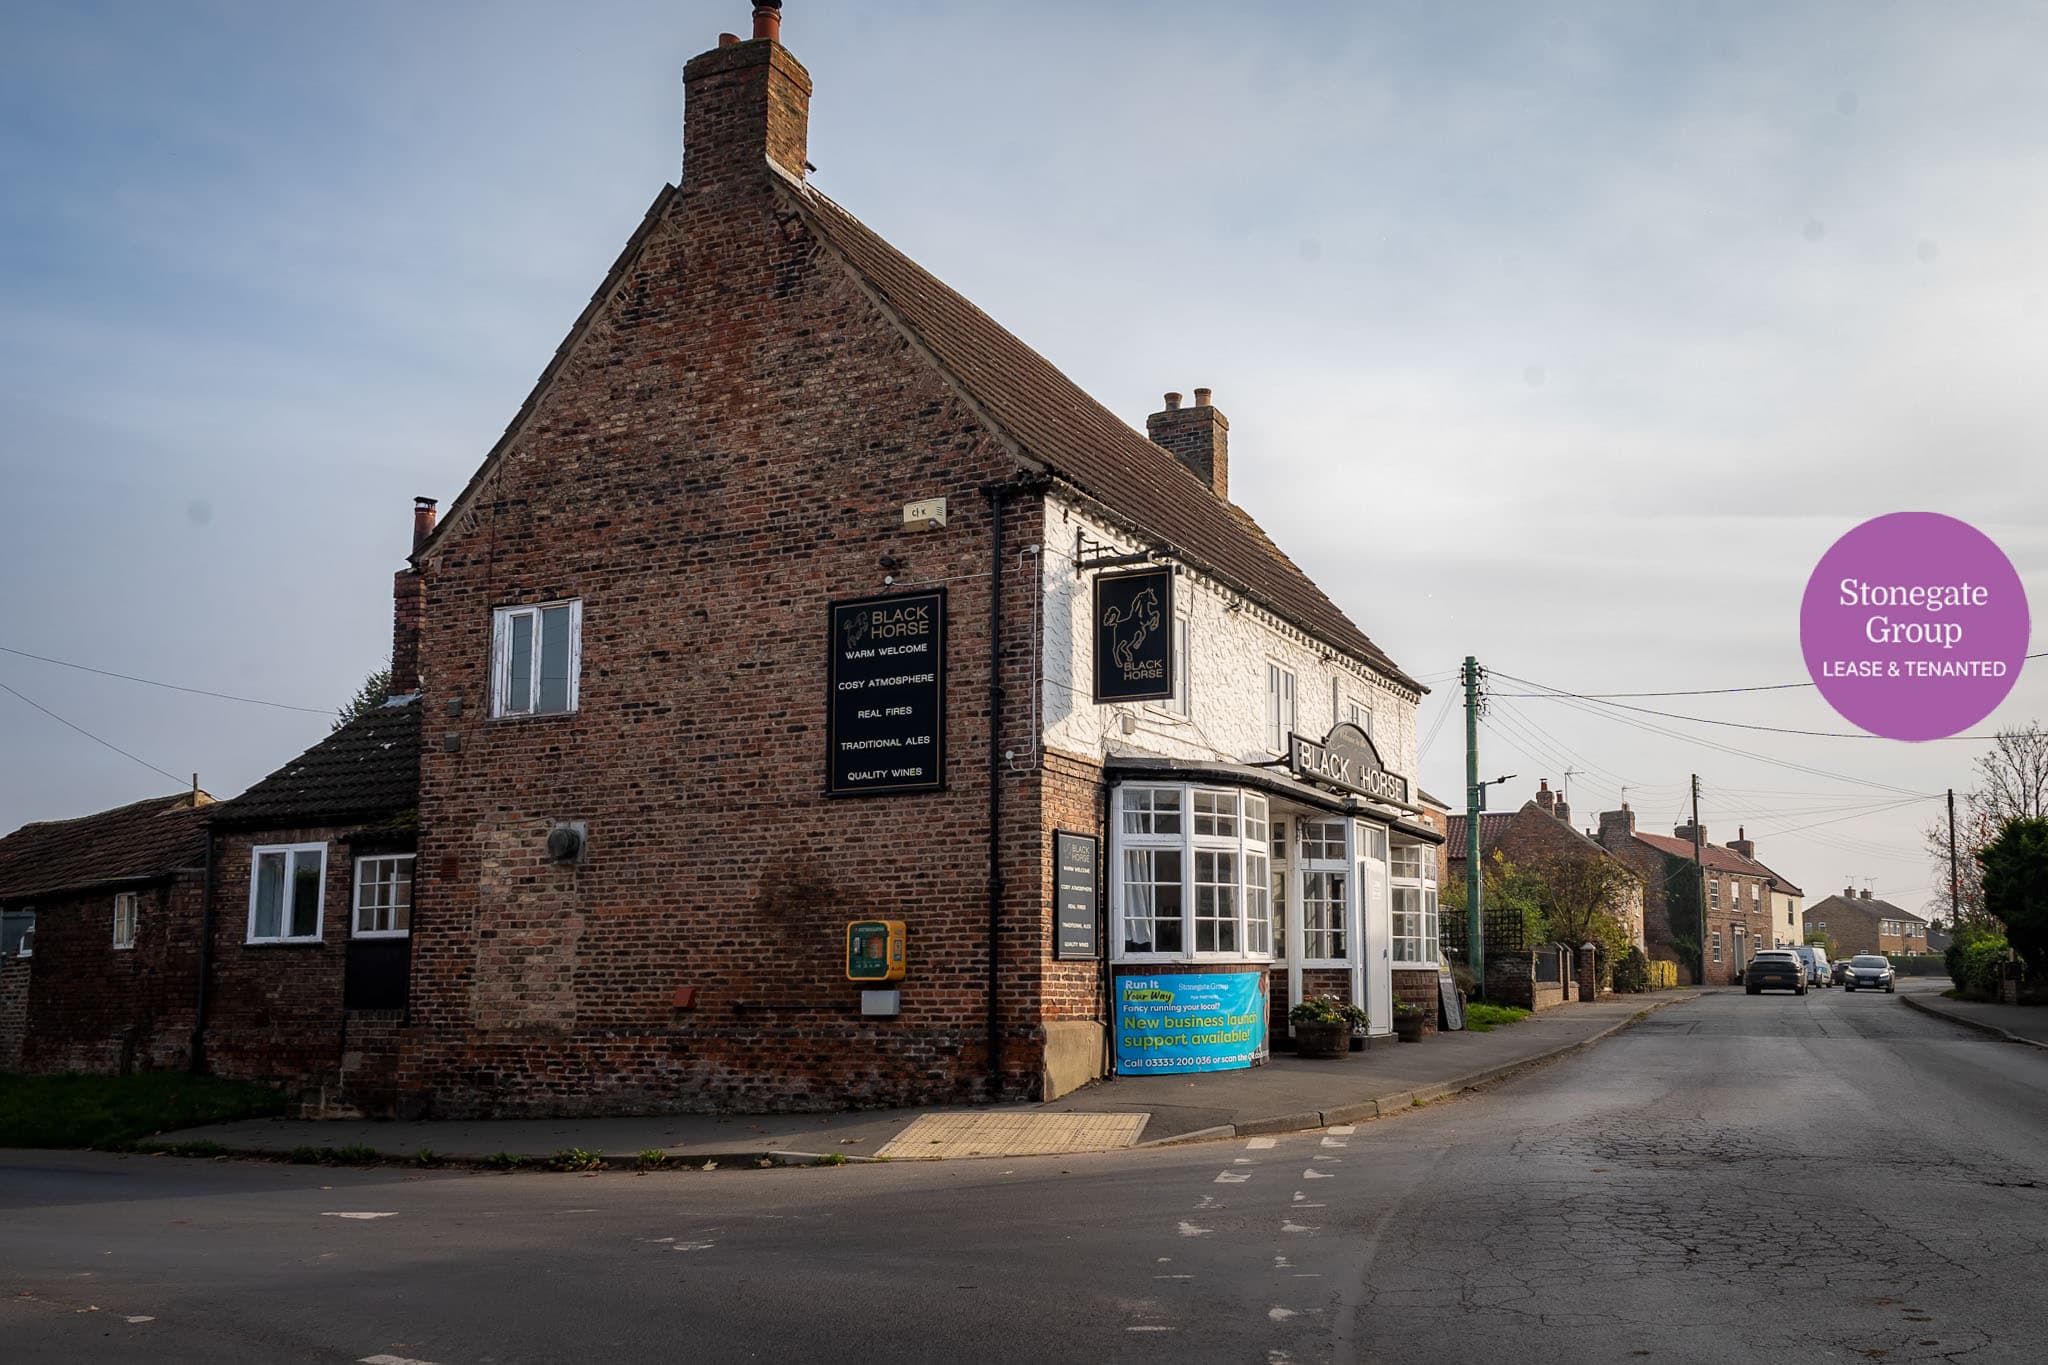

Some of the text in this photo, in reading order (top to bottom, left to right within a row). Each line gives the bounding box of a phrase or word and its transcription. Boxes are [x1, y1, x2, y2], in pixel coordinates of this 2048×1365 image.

[872, 605, 928, 625] BLACK
[871, 620, 929, 640] HORSE
[845, 643, 928, 660] WARM WELCOME
[1123, 659, 1163, 672] BLACK
[838, 673, 935, 690] COSY ATMOSPHERE
[1123, 669, 1164, 681] HORSE
[857, 706, 913, 719] REAL FIRES
[840, 735, 931, 751] TRADITIONAL ALES
[847, 767, 922, 781] QUALITY WINES
[1300, 742, 1403, 801] BLACK HORSE
[1125, 979, 1159, 989] Run It
[1126, 990, 1172, 1002] Your Way
[1123, 1004, 1148, 1014] Fancy
[1150, 1003, 1181, 1014] running
[1183, 1004, 1199, 1012] your
[1124, 1010, 1257, 1030] New business launch
[1124, 1030, 1250, 1050] support available!
[1124, 1058, 1143, 1068] Call
[1145, 1058, 1174, 1067] 03333
[1176, 1057, 1194, 1066] 200
[1195, 1056, 1211, 1065] 036
